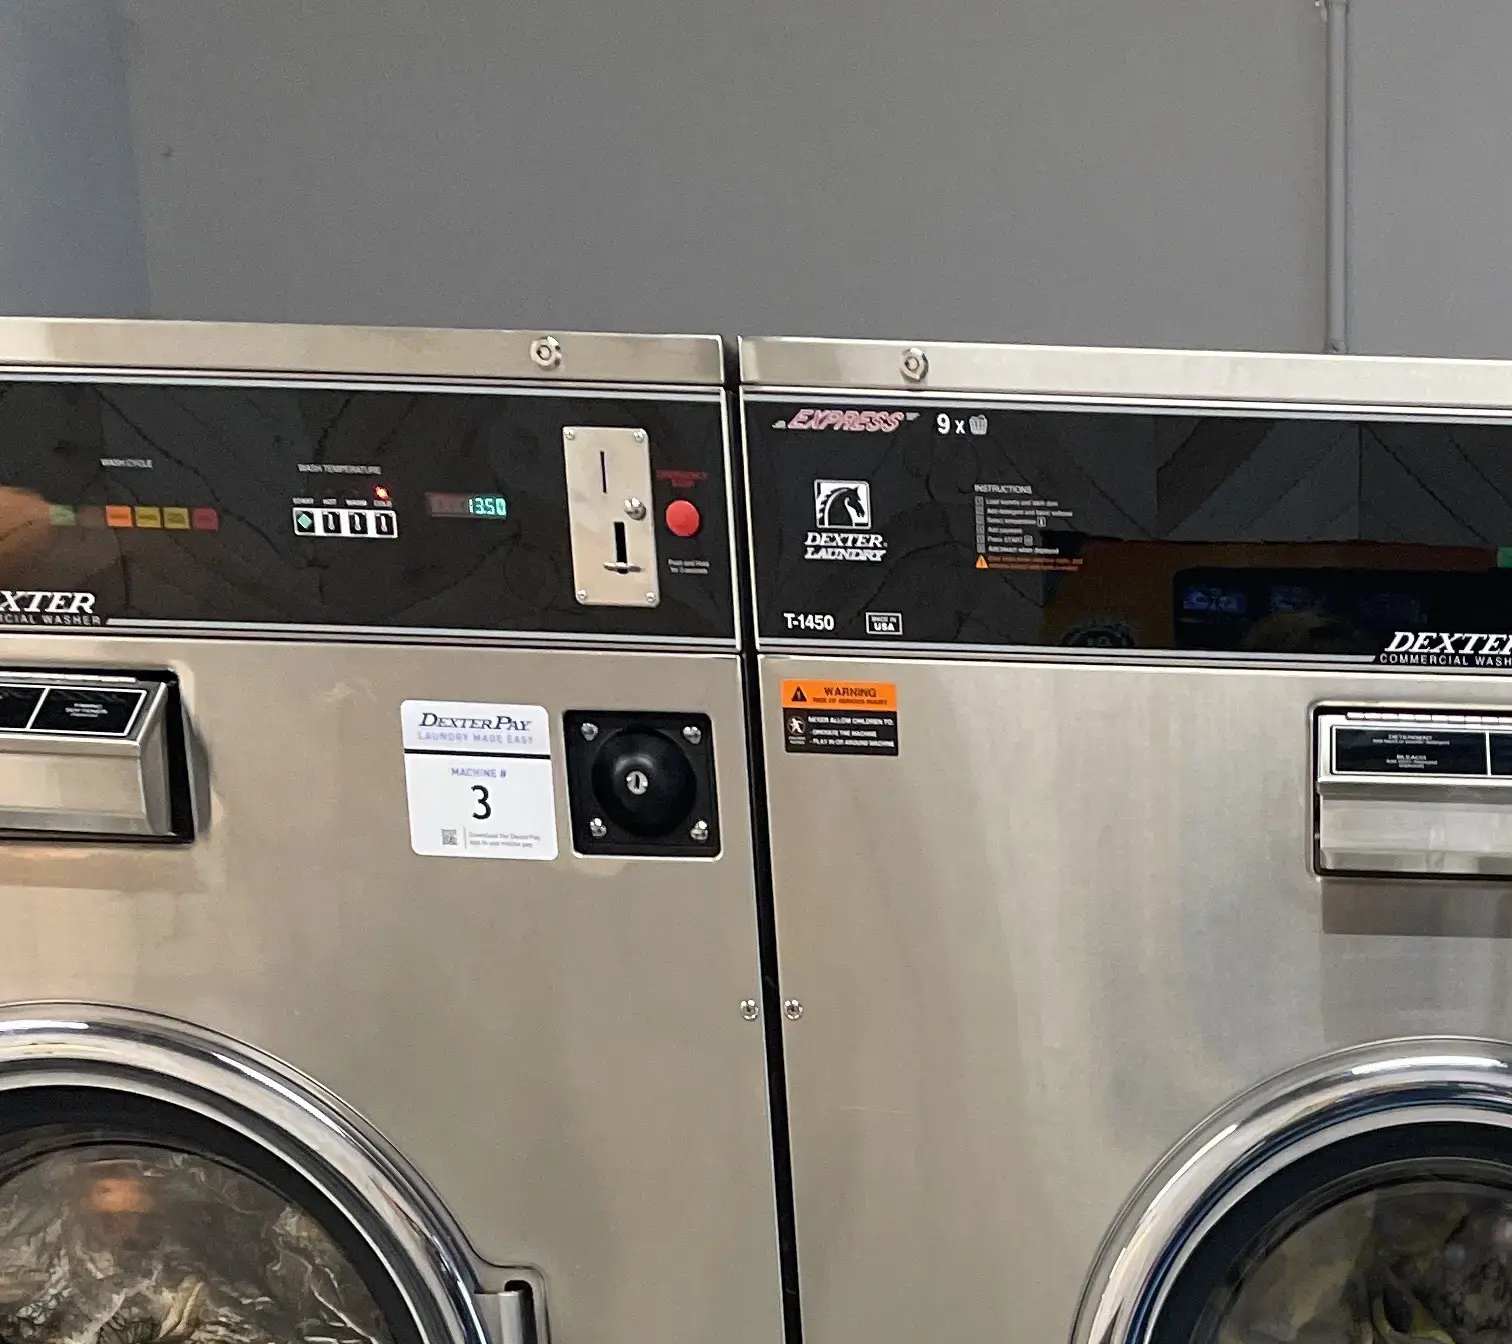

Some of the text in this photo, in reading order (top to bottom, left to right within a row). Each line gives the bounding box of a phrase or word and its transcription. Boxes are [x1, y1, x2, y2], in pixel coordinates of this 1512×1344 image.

[787, 408, 905, 432] EXPRESS
[936, 413, 950, 434] 9
[804, 531, 885, 548] DEXTER
[804, 547, 887, 562] LAUNDRY
[783, 613, 834, 631] T-1450
[874, 622, 895, 631] USA
[1379, 654, 1469, 667] COMMERCIAL
[824, 687, 877, 697] WARNING
[418, 732, 533, 745] LAUNDRY MADE EASY
[451, 768, 497, 778] MACHINE
[471, 785, 491, 820] 3
